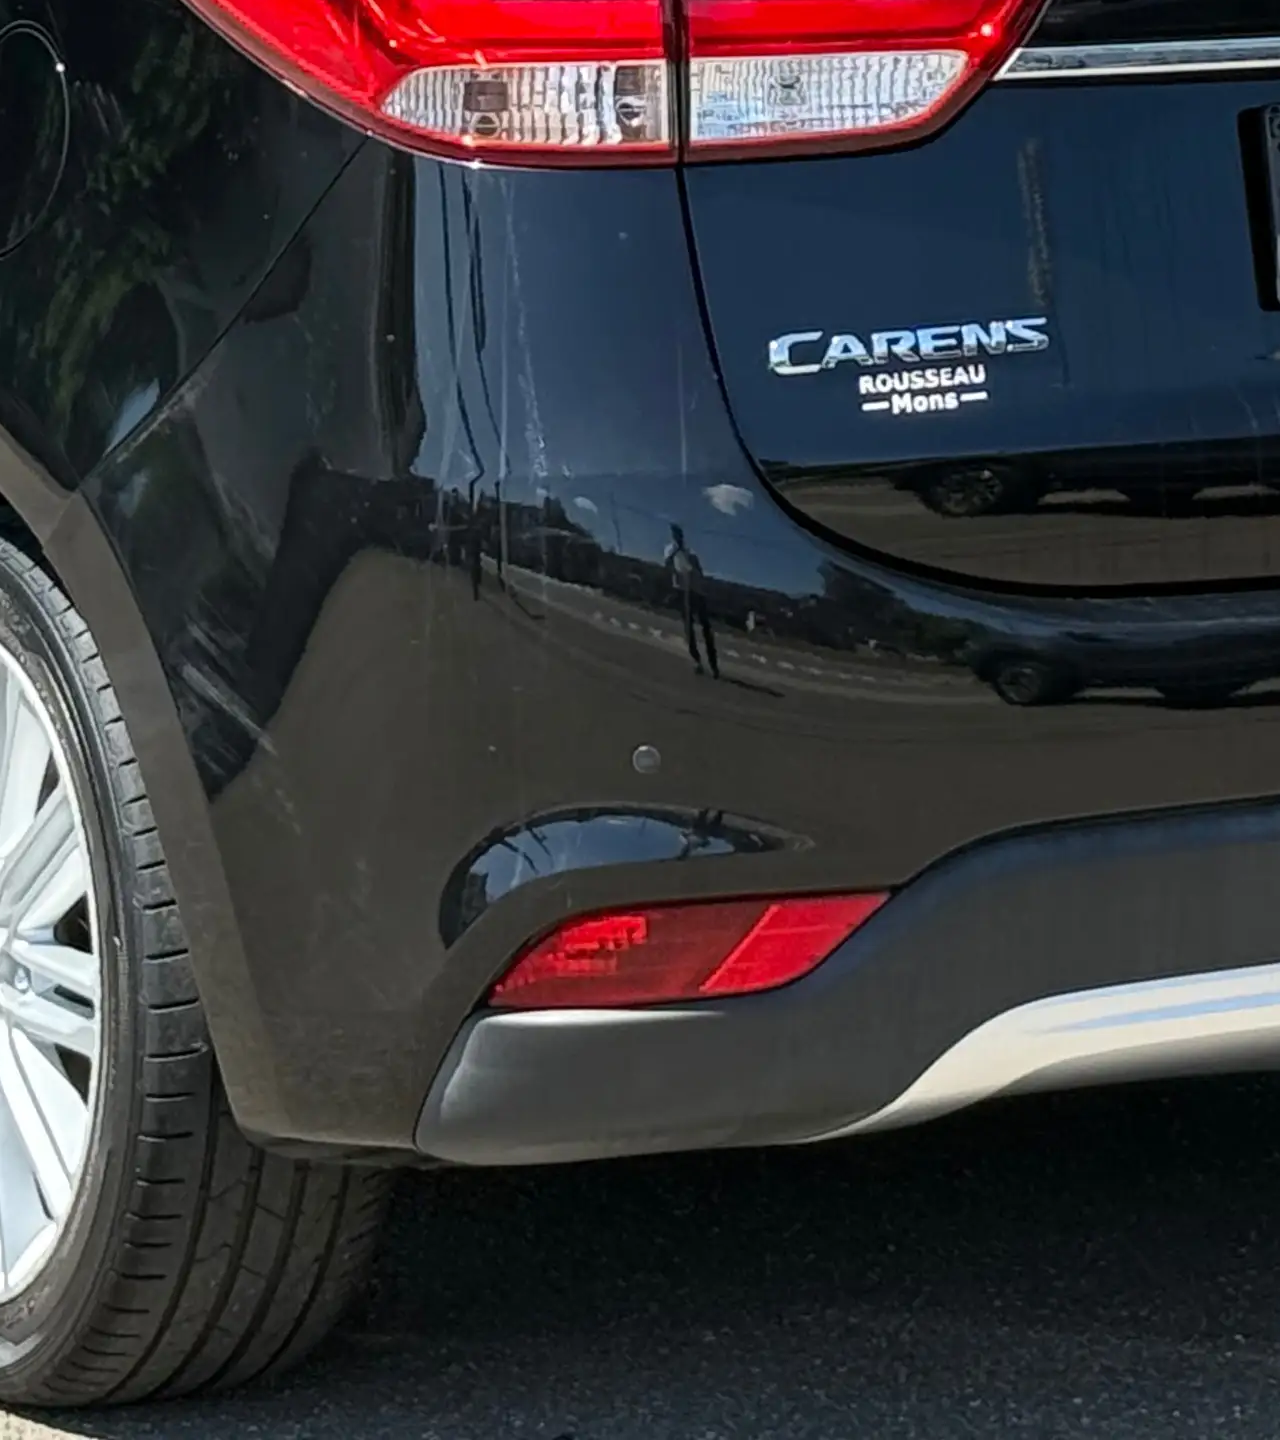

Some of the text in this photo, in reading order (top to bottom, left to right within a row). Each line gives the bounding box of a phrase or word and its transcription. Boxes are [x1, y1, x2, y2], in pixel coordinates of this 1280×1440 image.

[769, 316, 1050, 376] CARENS
[858, 363, 987, 395] ROUSSEAU
[891, 391, 960, 415] Mons
